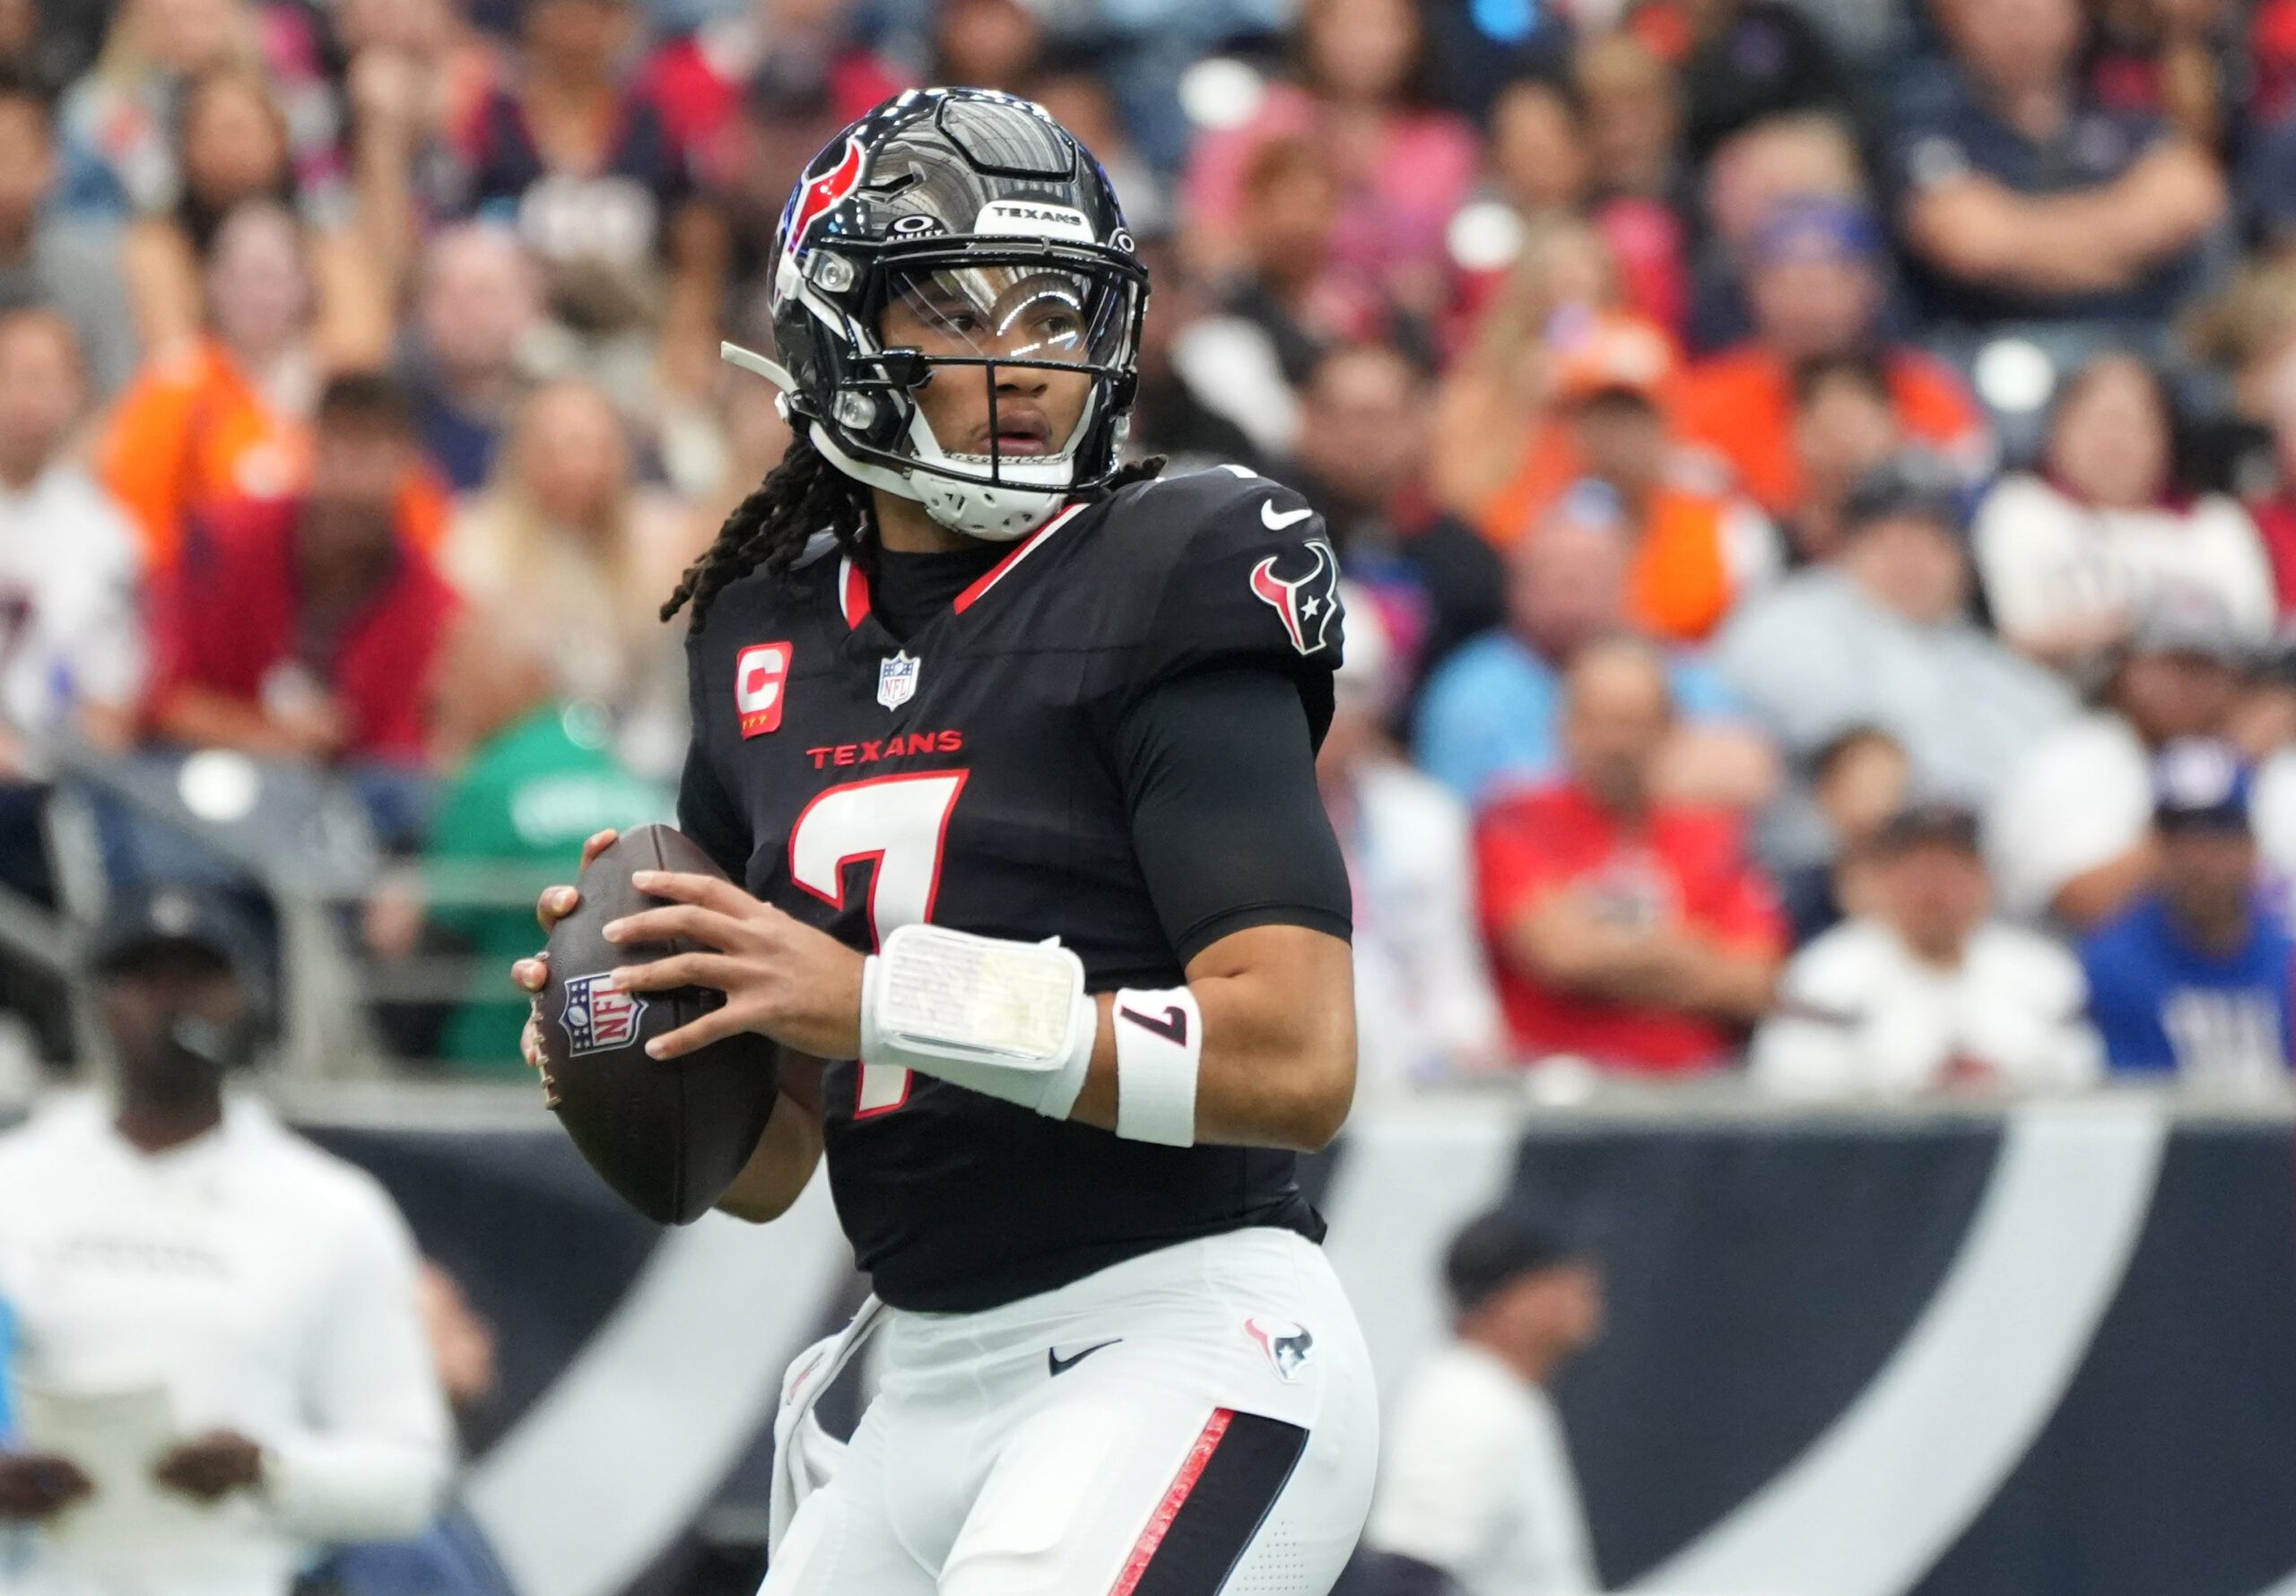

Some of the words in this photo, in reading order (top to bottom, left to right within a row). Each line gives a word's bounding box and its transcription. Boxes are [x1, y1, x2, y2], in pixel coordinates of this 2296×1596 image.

[992, 206, 1082, 225] TEXANS
[737, 649, 783, 714] C
[883, 678, 906, 697] NFL
[806, 730, 963, 769] TEXANS
[788, 768, 970, 1120] 7
[1119, 1004, 1187, 1048] 7
